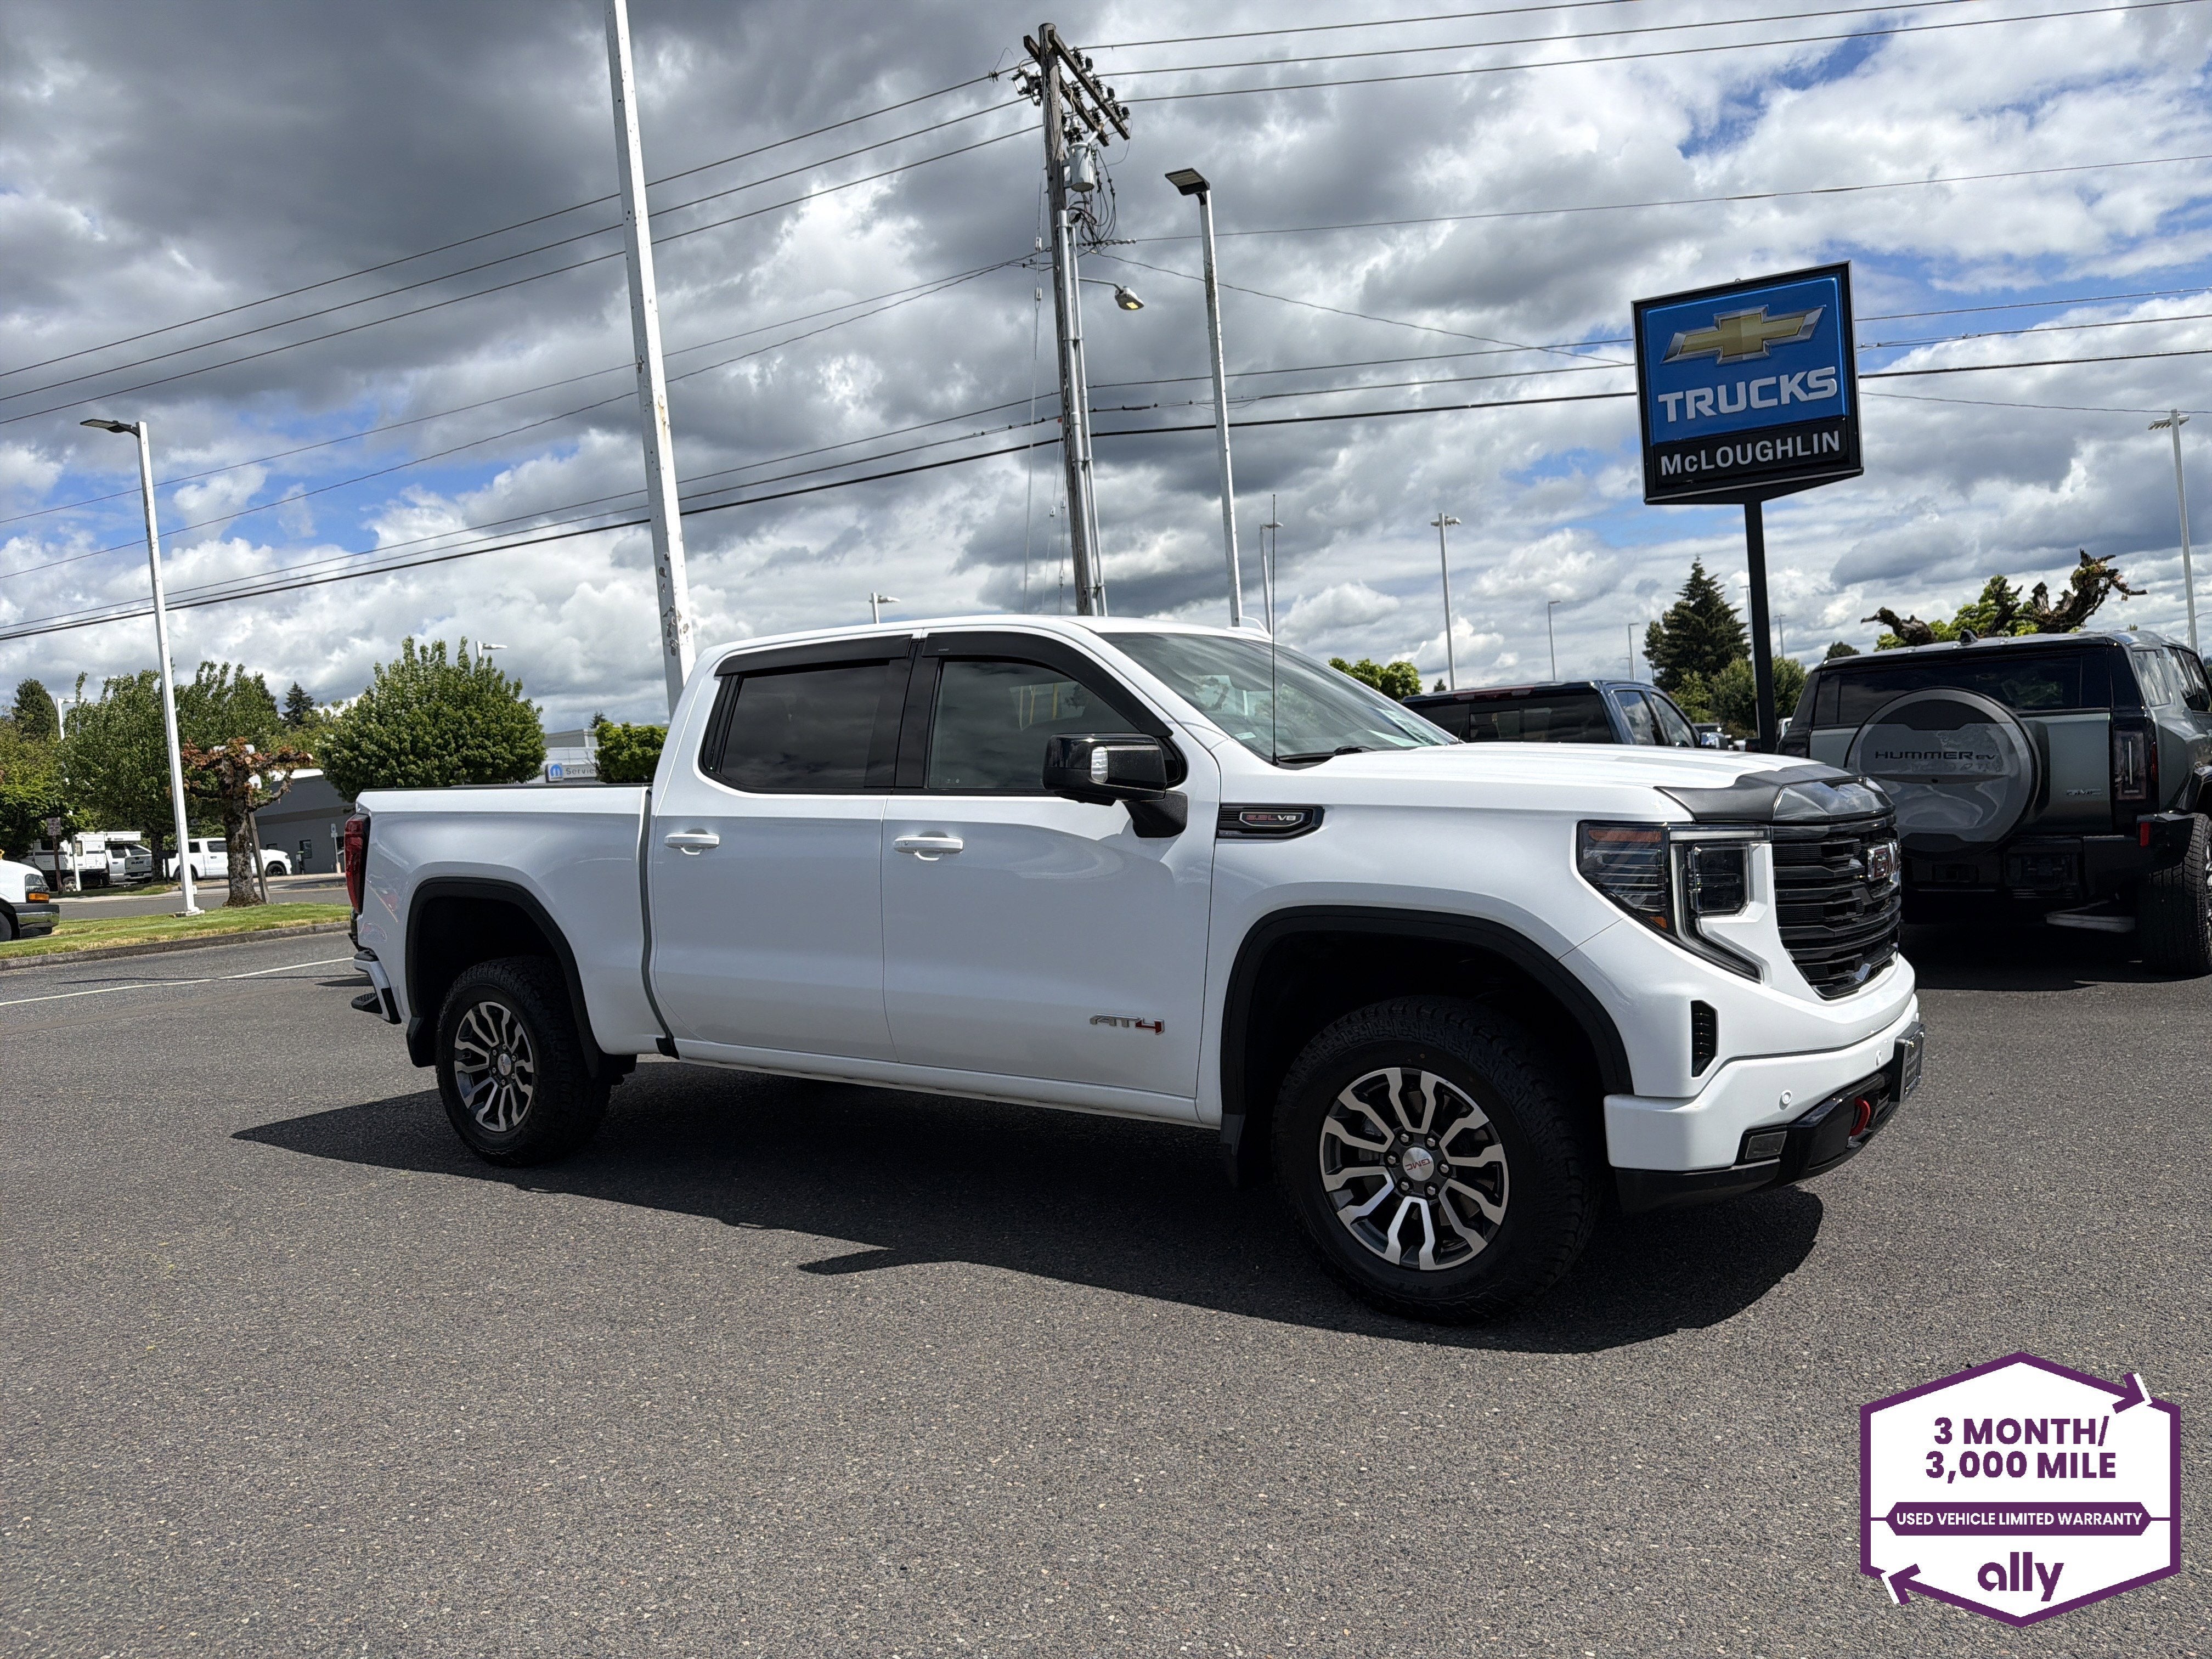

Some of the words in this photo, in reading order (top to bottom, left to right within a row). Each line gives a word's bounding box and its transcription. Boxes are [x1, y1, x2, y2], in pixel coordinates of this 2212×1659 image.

[1658, 366, 1837, 422] TRUCKS
[1661, 430, 1839, 476] McLOUGHLIN
[1875, 751, 1973, 759] HUMMER
[1090, 1014, 1165, 1035] AT4
[1405, 1158, 1430, 1171] GMC
